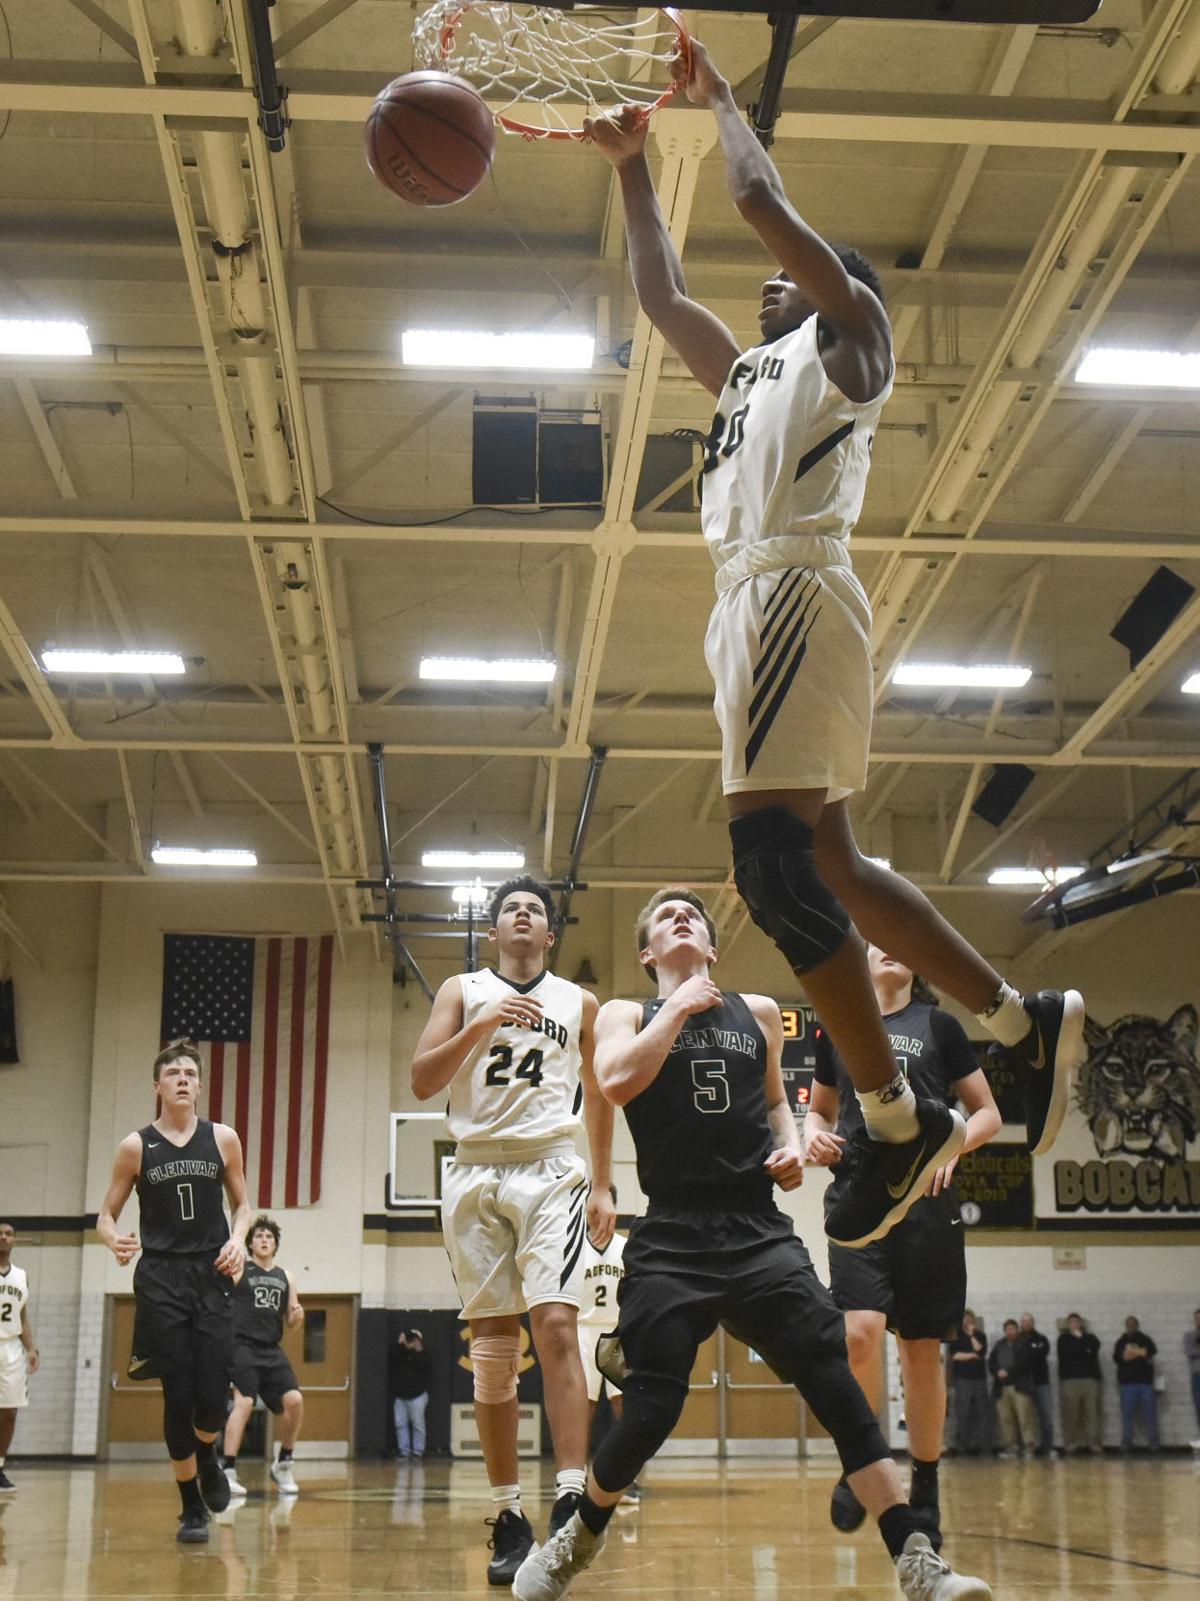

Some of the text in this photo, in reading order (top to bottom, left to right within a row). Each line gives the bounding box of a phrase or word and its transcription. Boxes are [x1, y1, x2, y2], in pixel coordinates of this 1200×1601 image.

[486, 1045, 544, 1088] 24
[691, 1059, 730, 1114] 5
[797, 1087, 809, 1105] 2
[147, 1160, 218, 1185] GLENVAR
[177, 1183, 194, 1220] 1
[254, 1286, 281, 1310] 24
[595, 1285, 607, 1307] 2
[1, 1302, 12, 1322] 2
